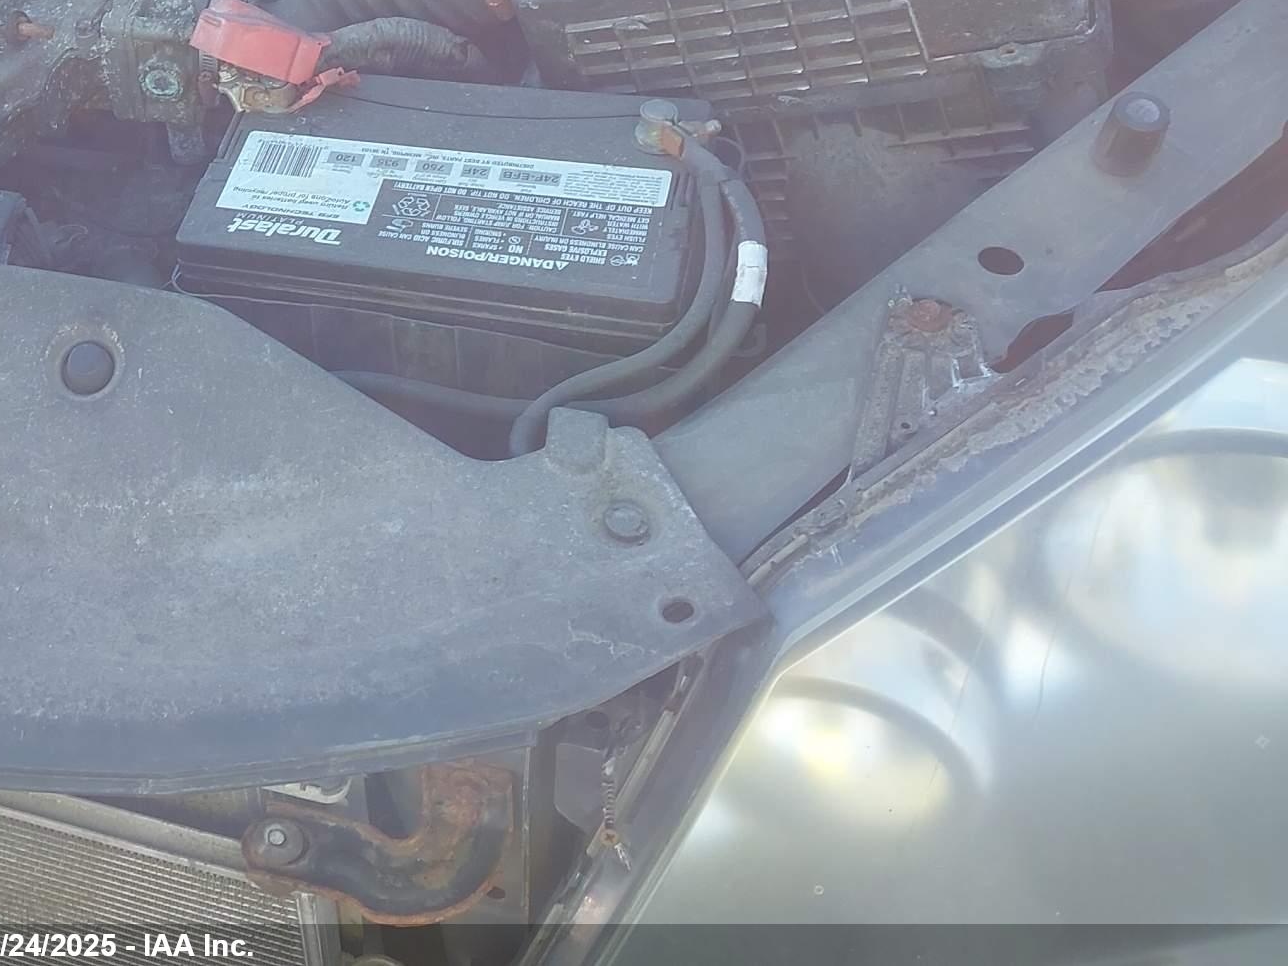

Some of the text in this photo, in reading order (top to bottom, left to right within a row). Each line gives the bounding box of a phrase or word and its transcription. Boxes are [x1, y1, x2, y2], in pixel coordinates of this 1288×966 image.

[335, 154, 356, 162] 120
[463, 167, 486, 175] 24F
[425, 184, 442, 192] OPEN
[550, 197, 561, 205] OF
[562, 199, 587, 207] REACH
[588, 201, 602, 209] THE
[240, 203, 313, 215] TECHNOLOGY
[617, 204, 632, 212] OUT
[633, 206, 652, 214] KEEP
[235, 212, 304, 224] PLATINUM
[225, 217, 342, 244] Duralast
[377, 230, 398, 238] CAUSE
[412, 234, 429, 242] ACID
[474, 235, 499, 243] FLAMES
[507, 244, 523, 253] NO
[544, 243, 607, 256] EXPLOSIVE GASES
[425, 246, 553, 265] DANGER/POISON
[560, 253, 605, 264] SHIELD EYES
